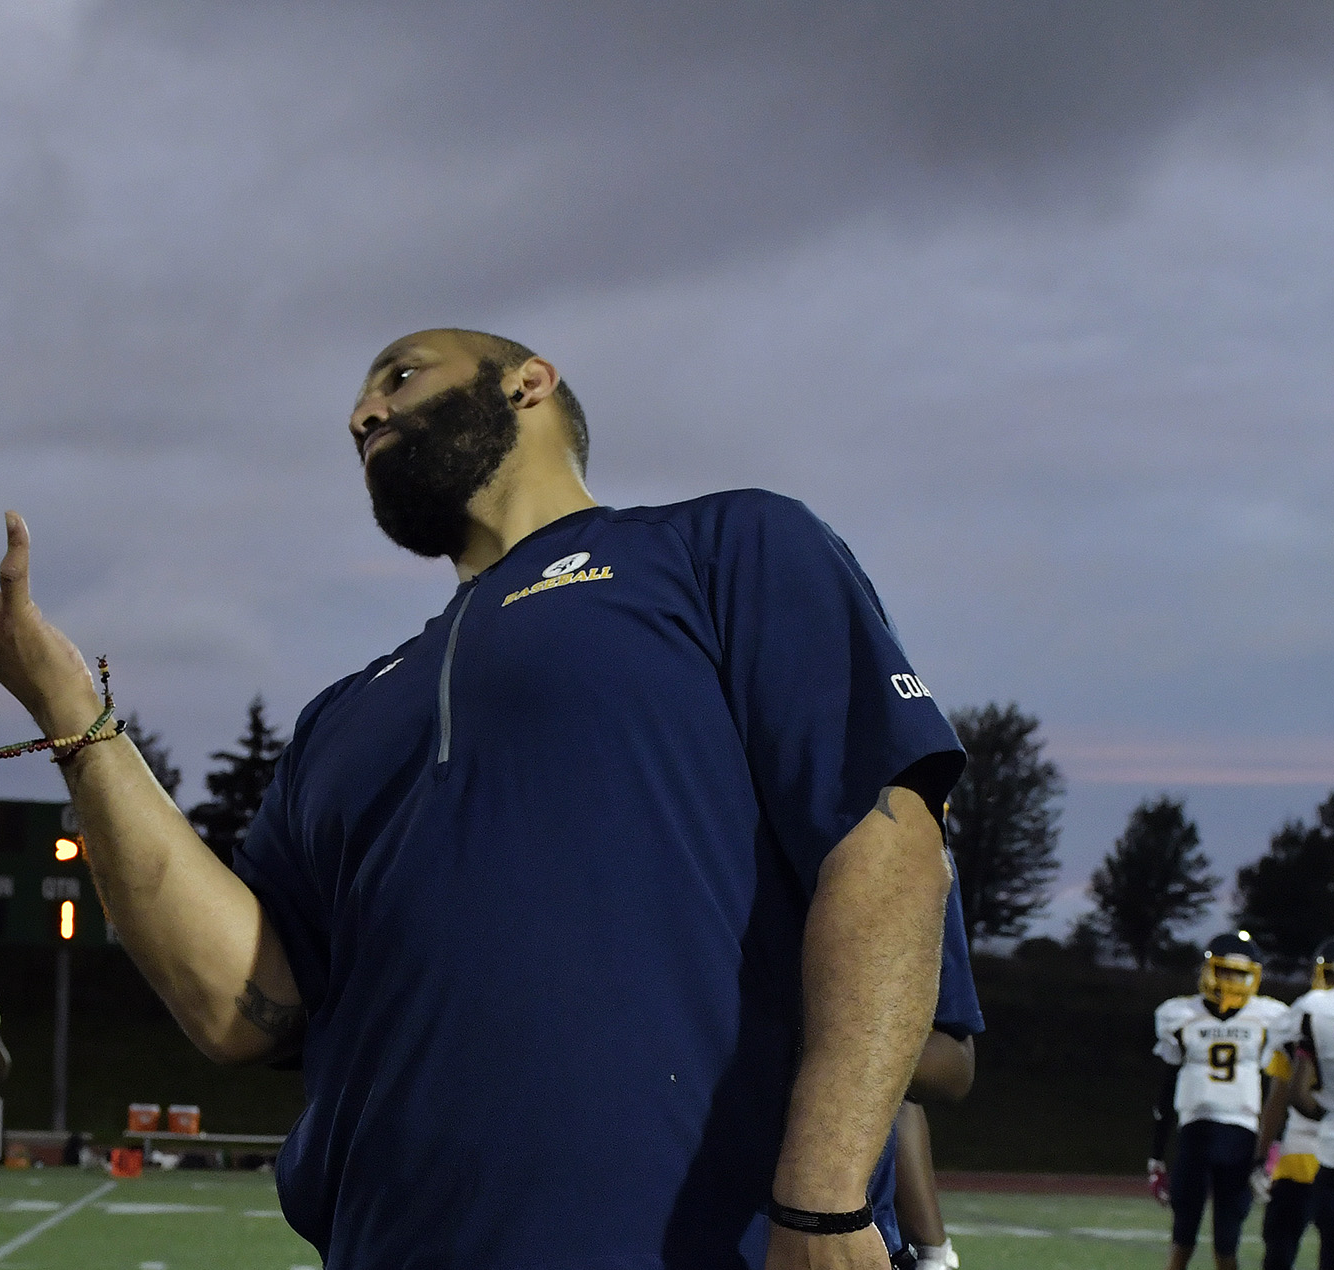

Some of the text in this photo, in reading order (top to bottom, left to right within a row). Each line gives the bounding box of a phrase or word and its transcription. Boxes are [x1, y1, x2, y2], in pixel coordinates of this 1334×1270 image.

[501, 565, 614, 607] BASEBALL
[60, 900, 75, 940] 1
[1207, 1041, 1238, 1082] 9
